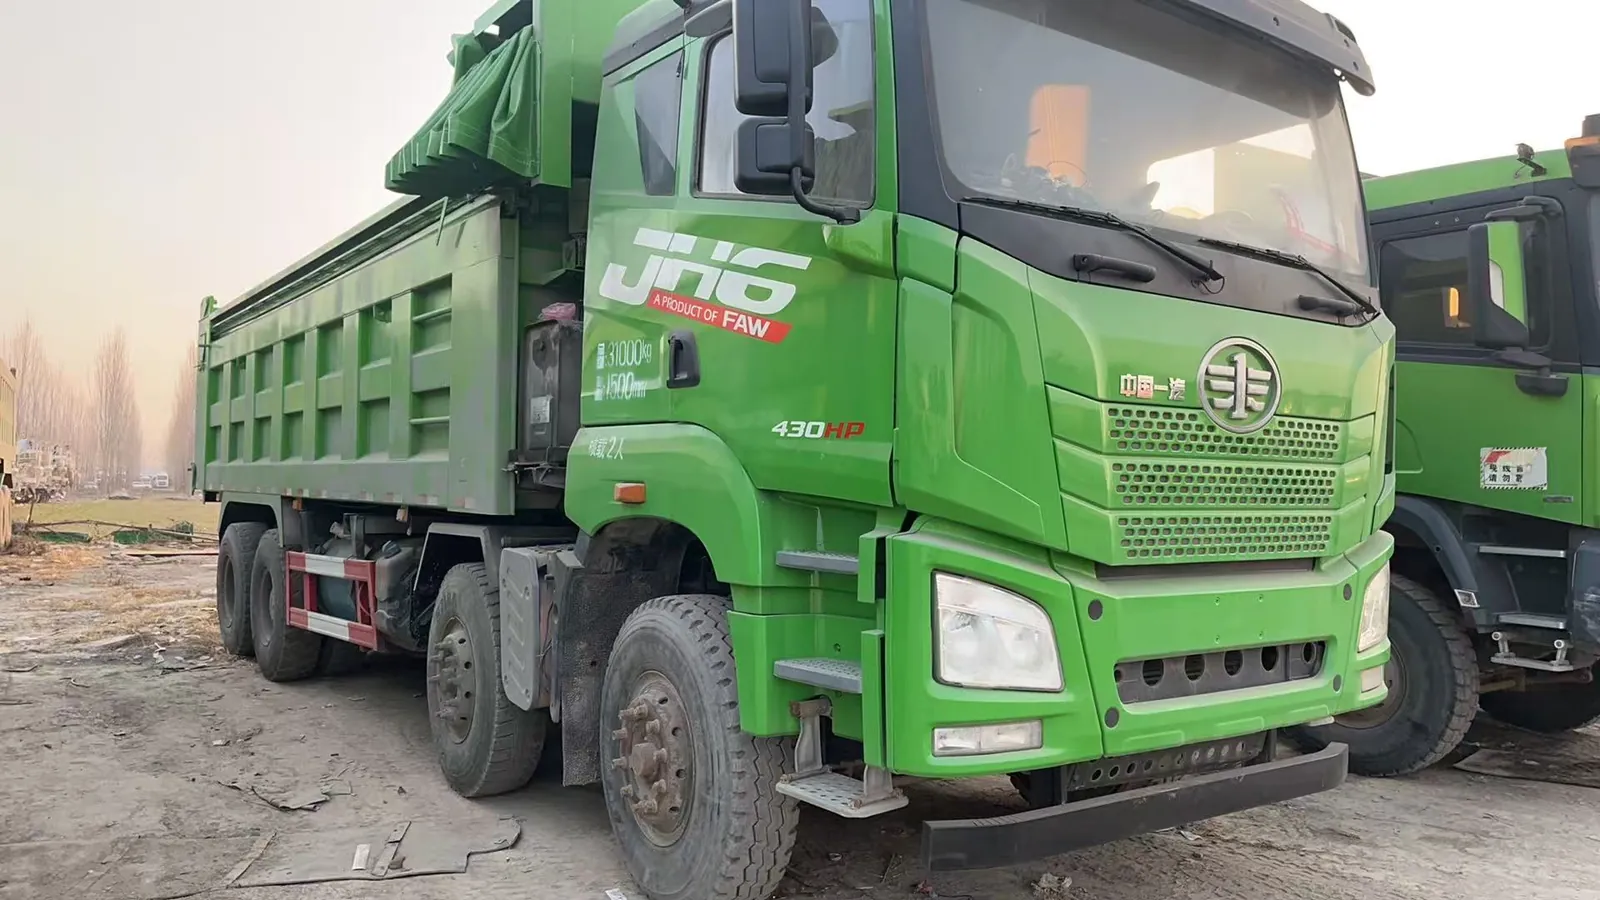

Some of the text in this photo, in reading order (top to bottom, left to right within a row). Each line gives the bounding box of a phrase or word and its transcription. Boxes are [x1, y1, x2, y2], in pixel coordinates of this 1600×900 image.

[599, 227, 813, 314] JH6
[653, 294, 771, 338] A PRODUCT OF FAW
[1120, 373, 1186, 401] 中国一汽
[771, 421, 865, 440] 430HP
